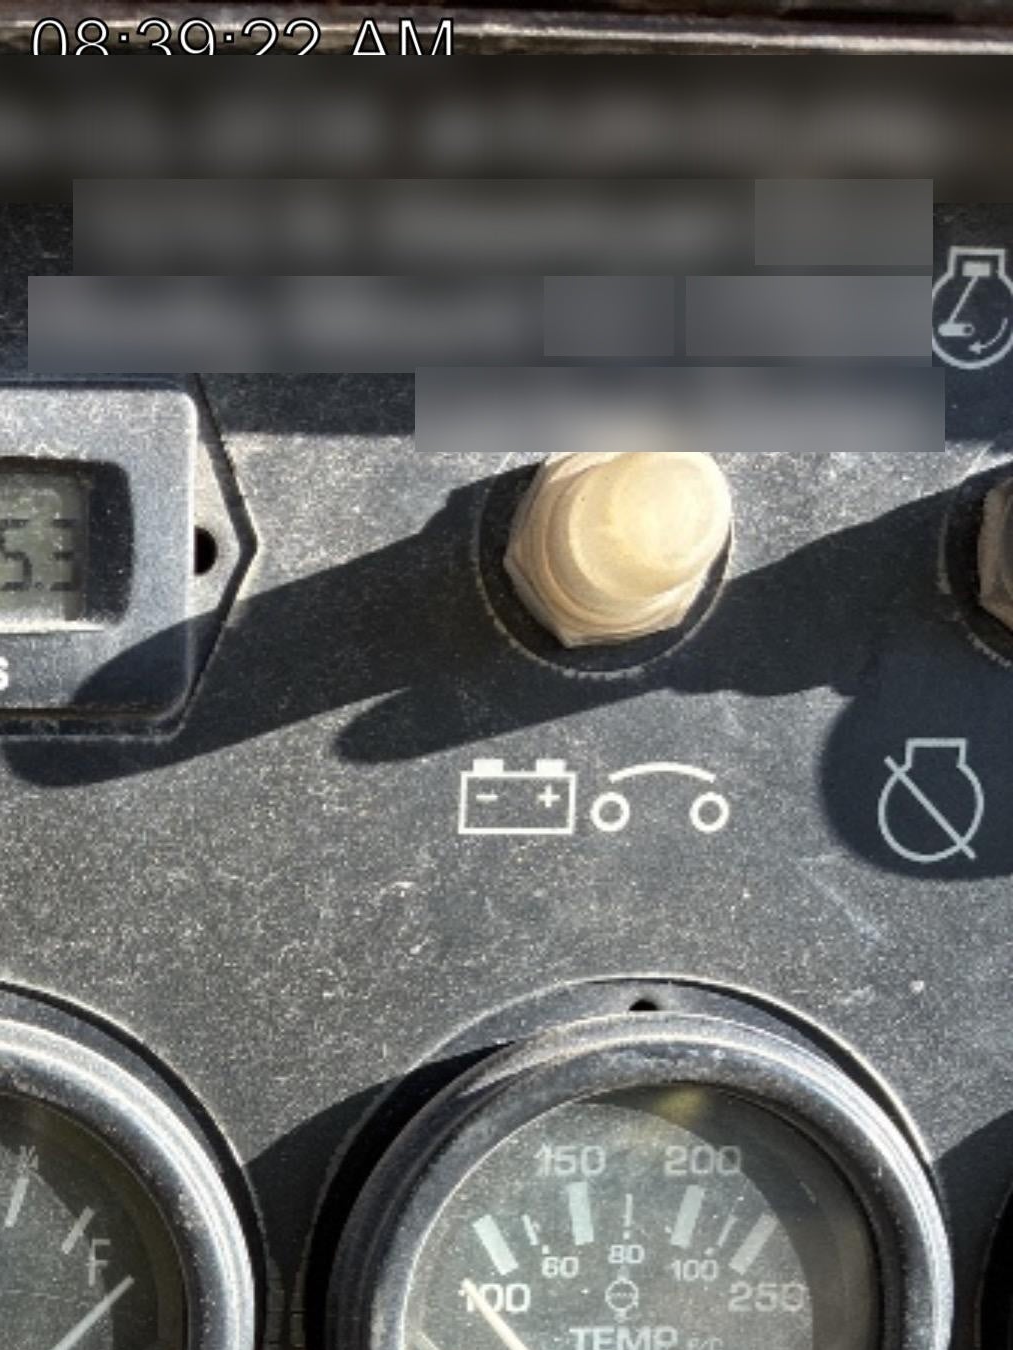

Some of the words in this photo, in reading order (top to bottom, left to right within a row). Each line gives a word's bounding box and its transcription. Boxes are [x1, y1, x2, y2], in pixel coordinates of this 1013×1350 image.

[539, 1144, 606, 1177] 150
[663, 1144, 743, 1177] 200
[85, 1238, 111, 1287] F
[607, 1243, 645, 1265] 80
[671, 1258, 720, 1283] 100
[463, 1282, 531, 1314] 100
[728, 1282, 808, 1313] 250
